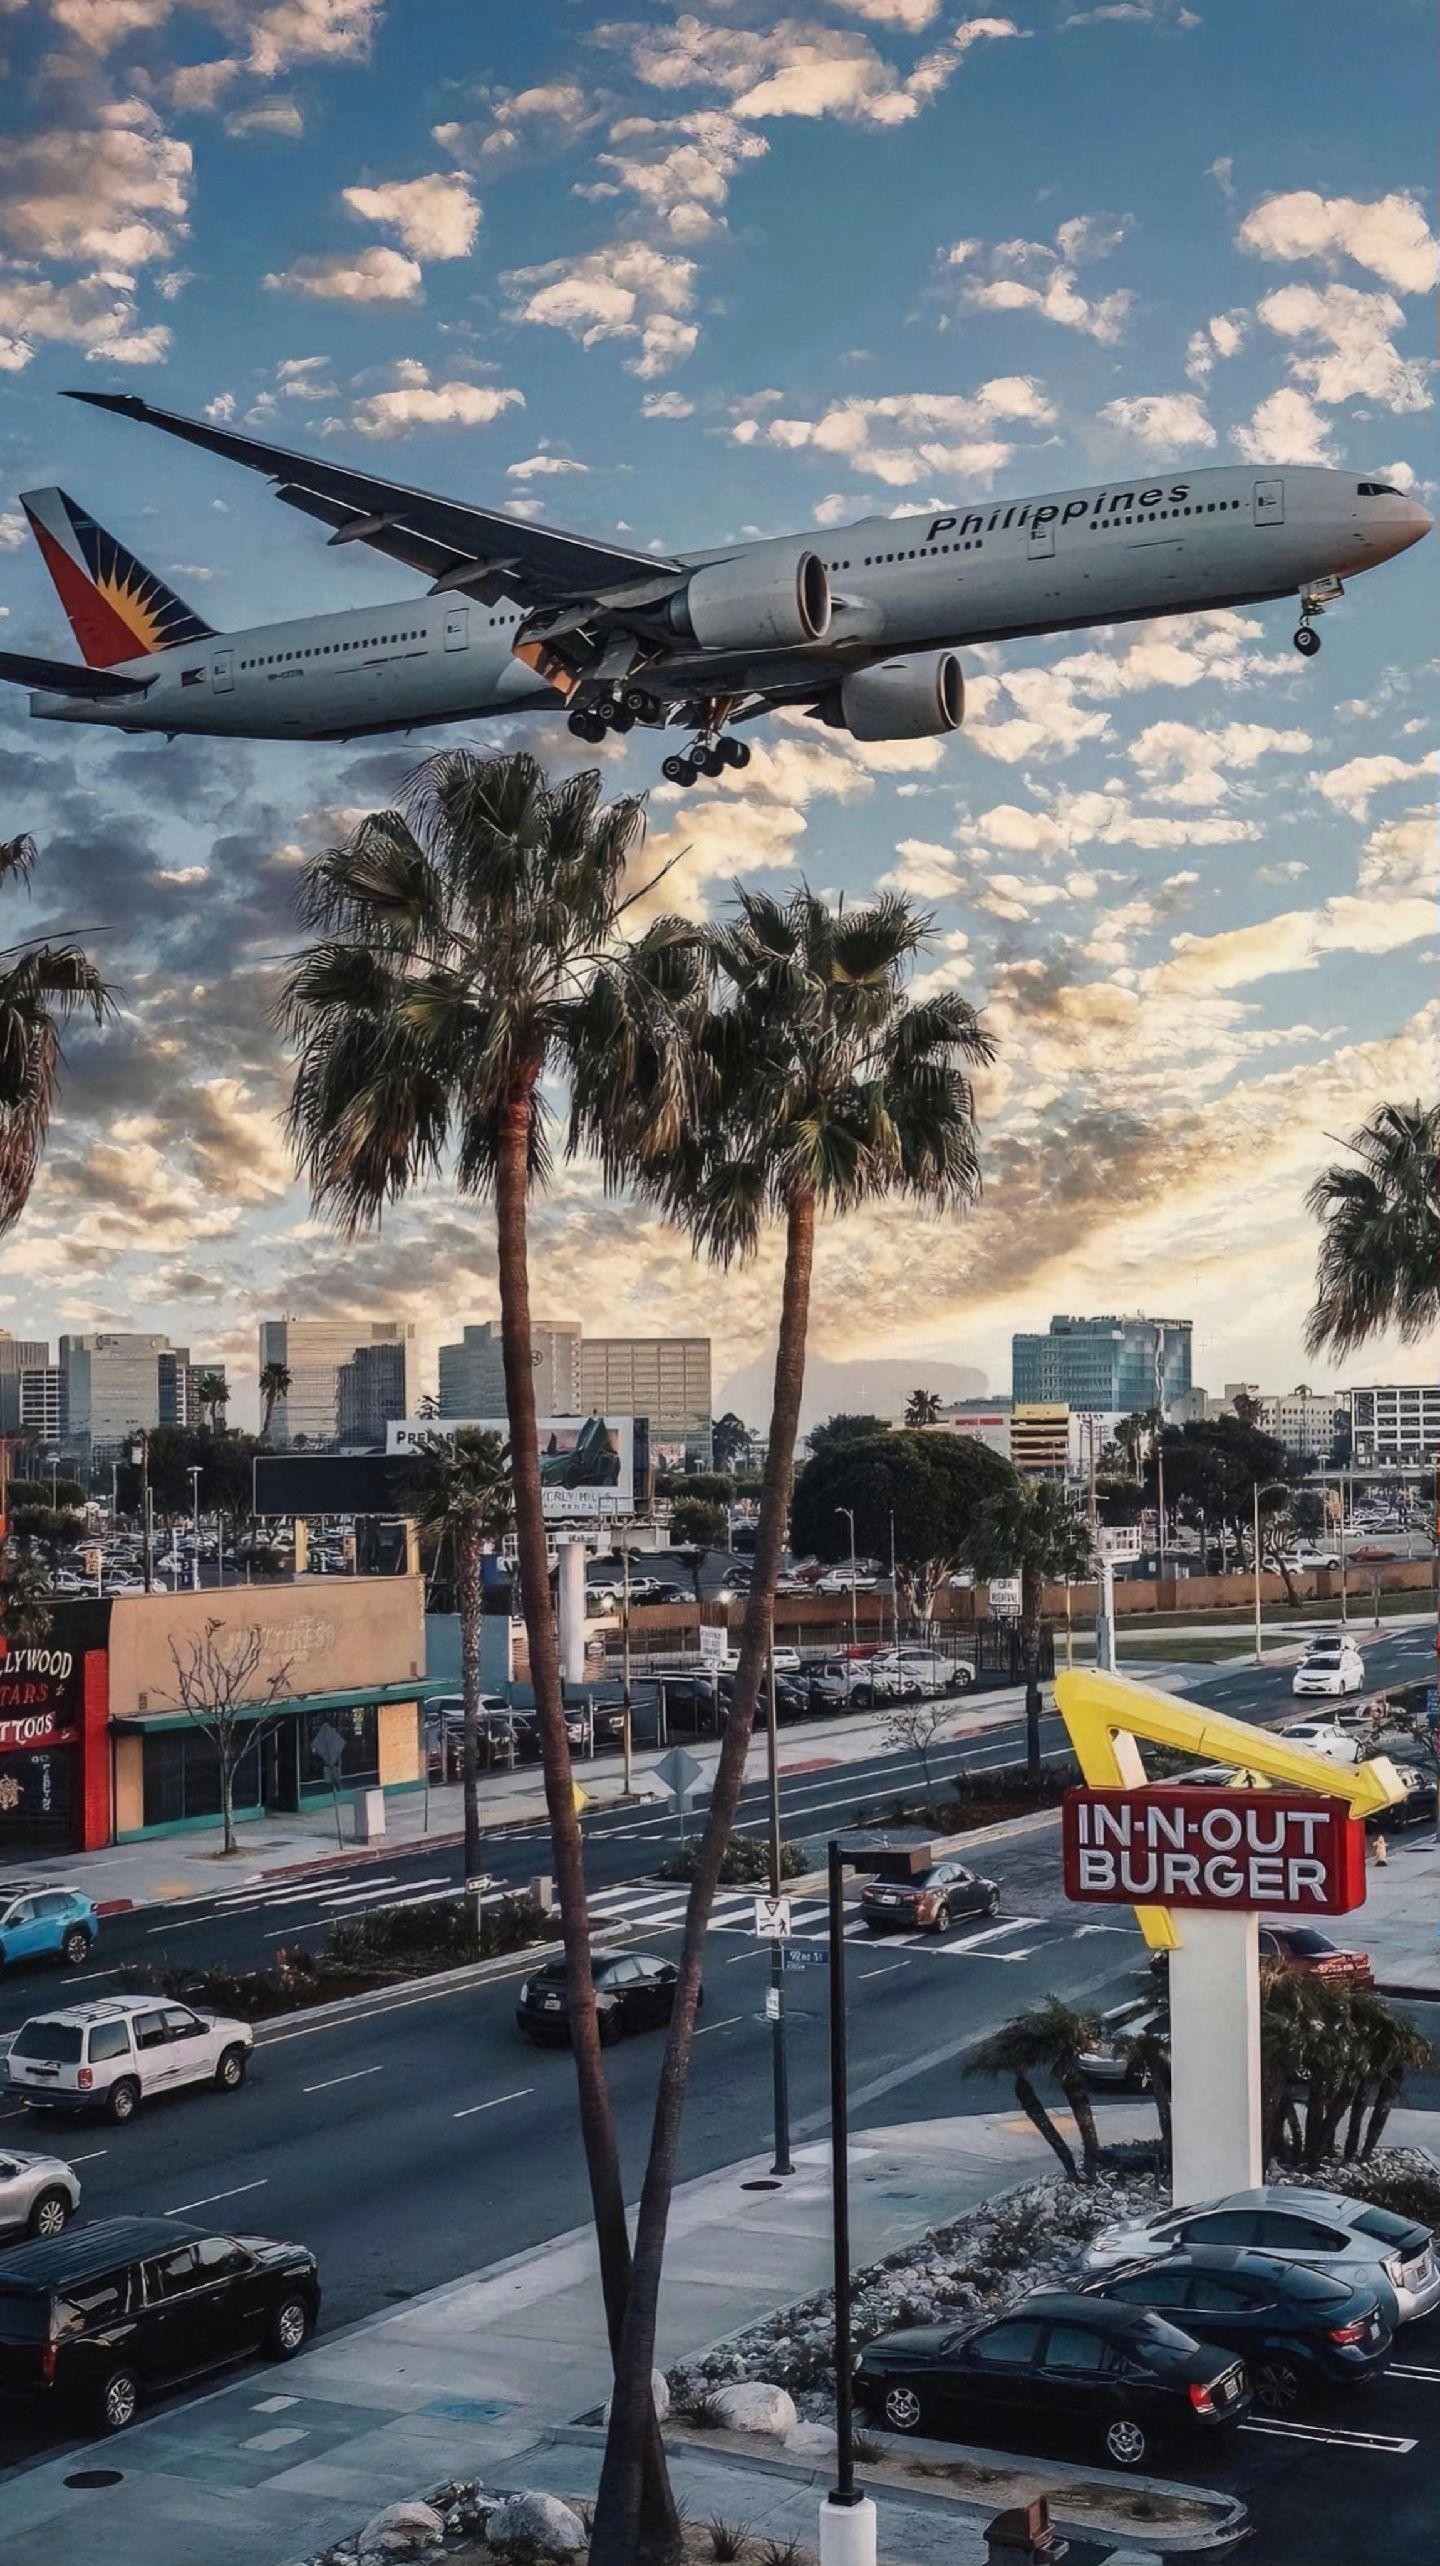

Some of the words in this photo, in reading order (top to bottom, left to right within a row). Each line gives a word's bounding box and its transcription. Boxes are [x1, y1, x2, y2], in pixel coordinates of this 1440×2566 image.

[926, 484, 1191, 542] Philippines
[0, 1648, 73, 1679] LYWOOD
[1078, 1803, 1330, 1855] IN-N-OUT
[1078, 1848, 1328, 1901] BURGER
